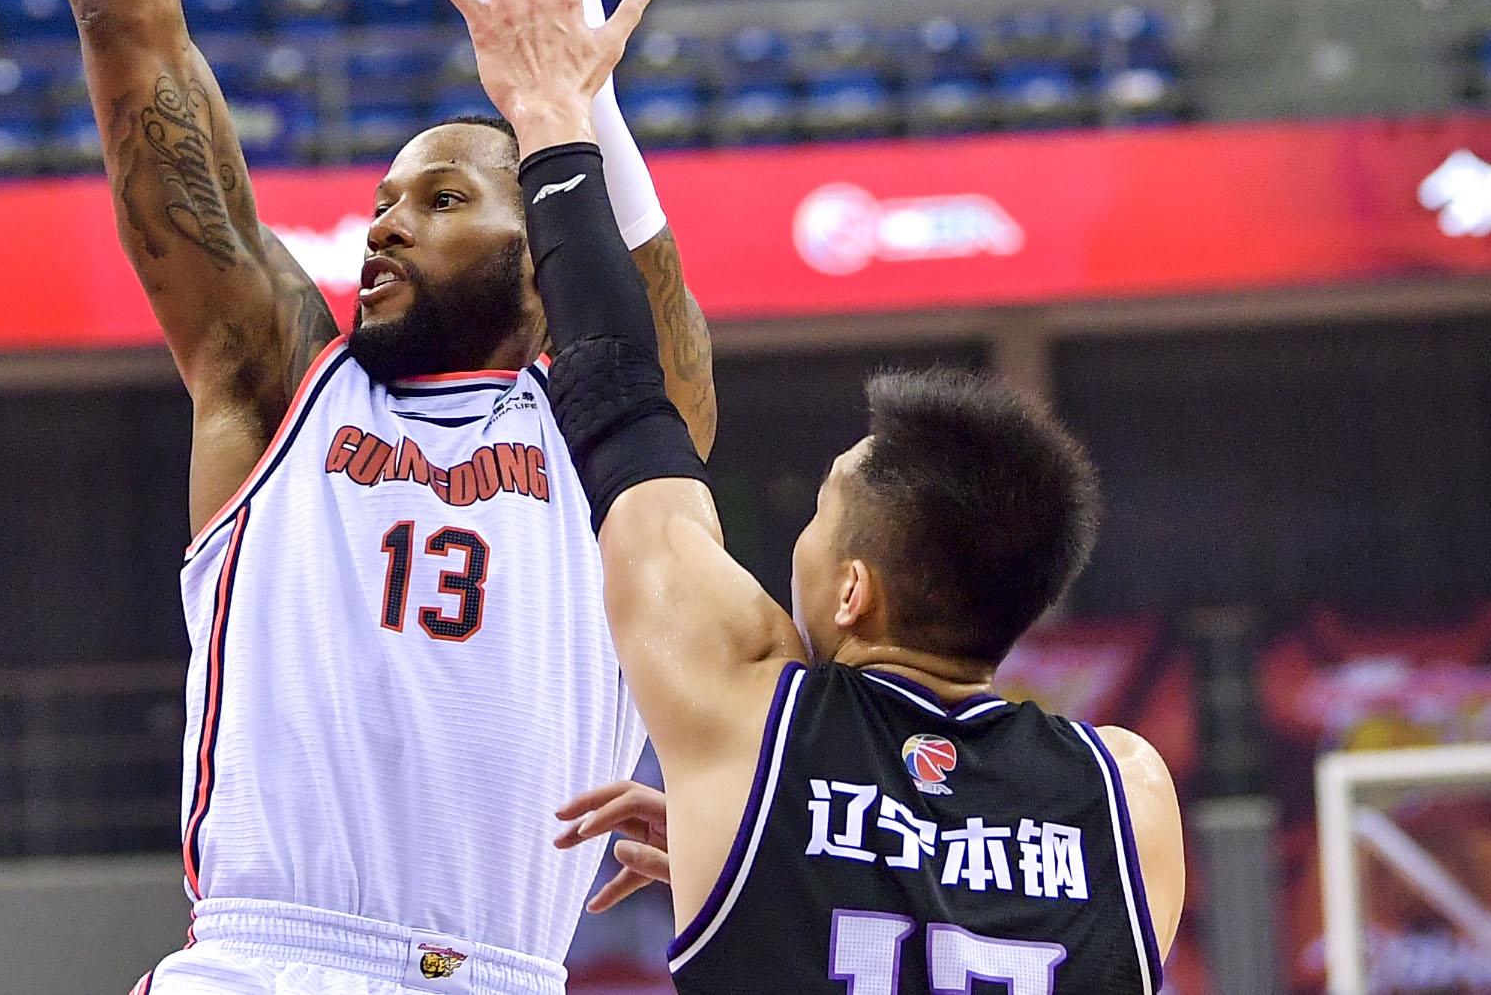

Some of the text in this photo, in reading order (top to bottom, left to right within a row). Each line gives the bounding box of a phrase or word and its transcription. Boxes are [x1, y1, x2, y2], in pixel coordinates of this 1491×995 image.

[325, 425, 550, 506] GUANGDONG
[380, 520, 490, 642] 13
[804, 778, 1089, 900] 辽宁本钢
